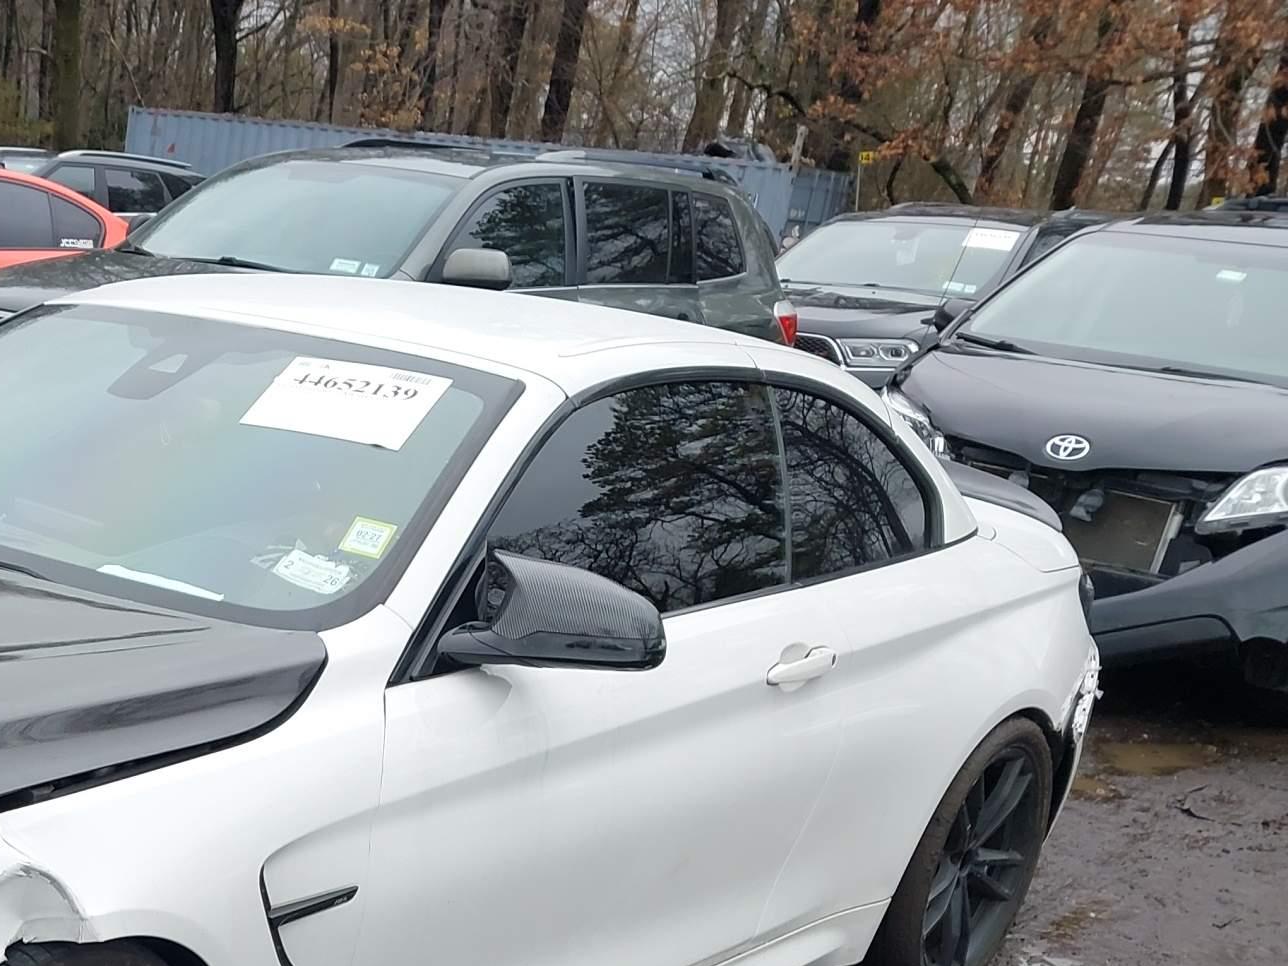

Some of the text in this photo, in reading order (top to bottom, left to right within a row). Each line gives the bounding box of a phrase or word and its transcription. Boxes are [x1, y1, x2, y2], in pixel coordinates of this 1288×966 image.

[293, 372, 419, 400] 44652139
[283, 560, 295, 570] 2
[322, 574, 340, 586] 26
